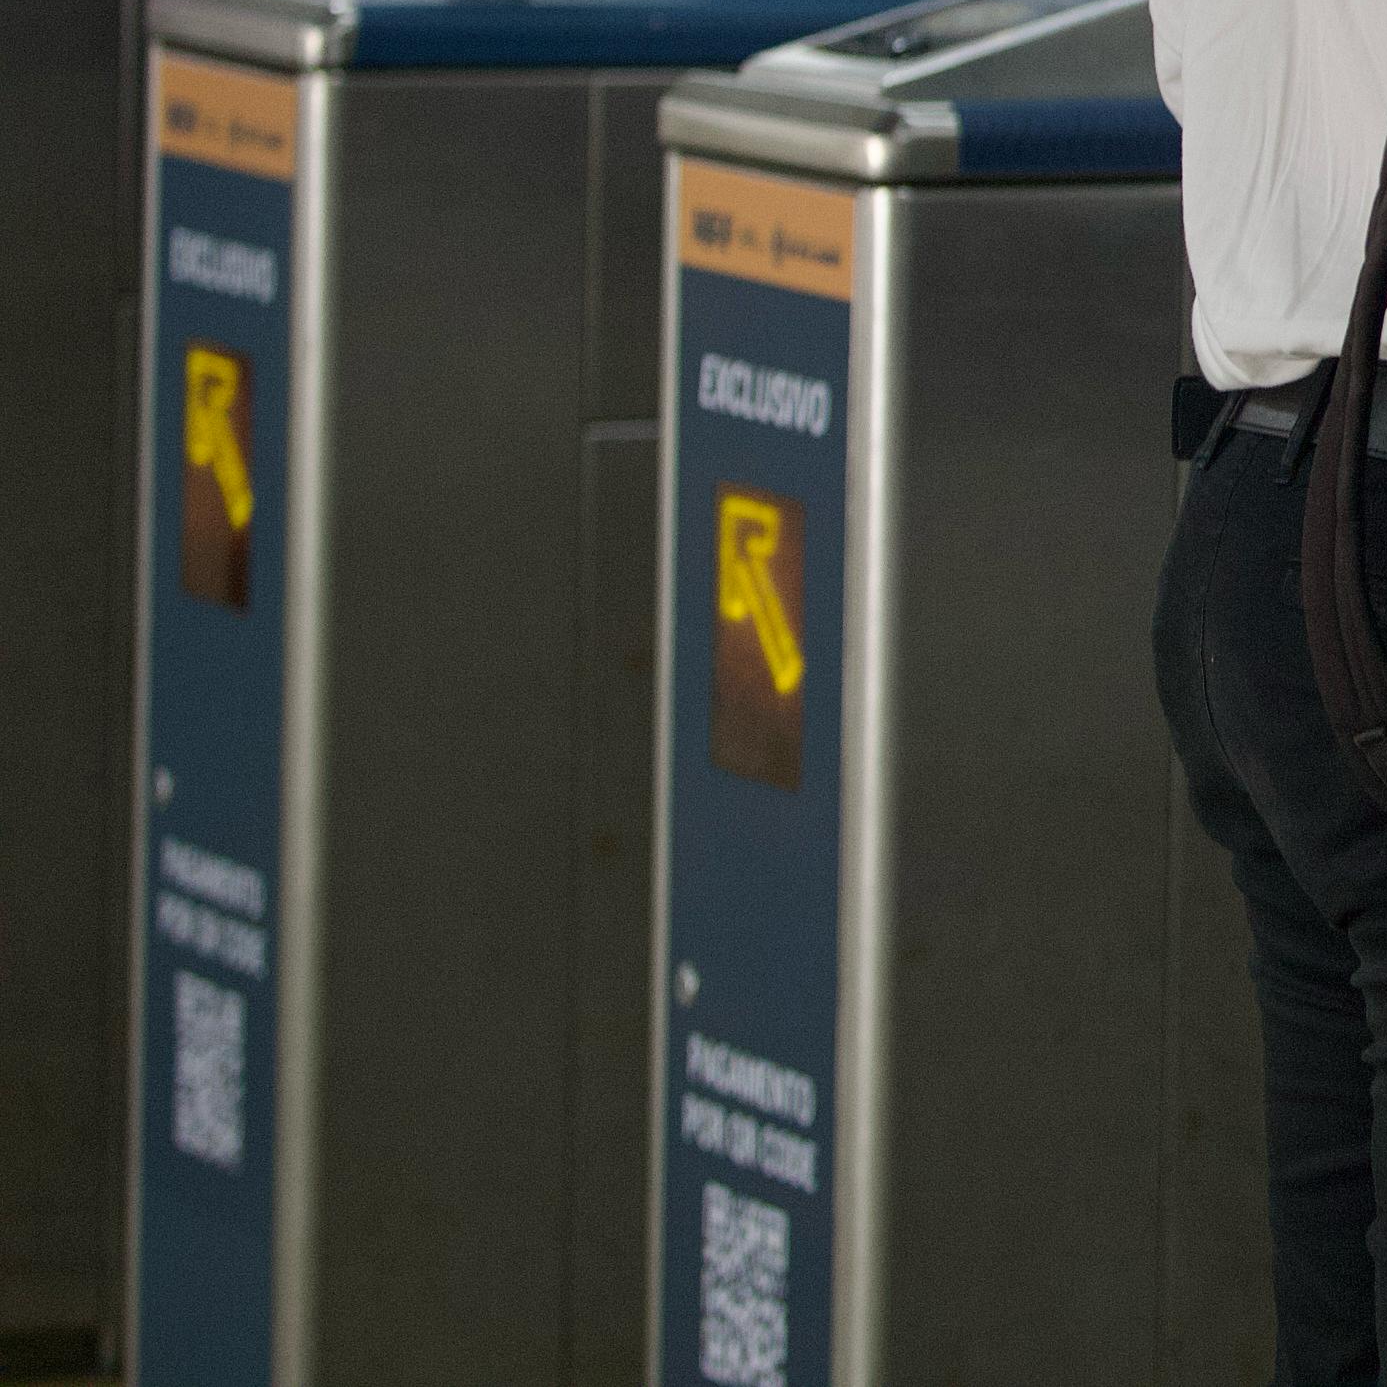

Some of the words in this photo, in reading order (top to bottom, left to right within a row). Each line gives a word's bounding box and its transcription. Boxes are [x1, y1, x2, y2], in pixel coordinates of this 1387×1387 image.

[698, 352, 832, 437] EXCLUSIVO
[686, 1032, 816, 1128] PAGAMENTO
[681, 1091, 726, 1156] POR
[759, 1123, 819, 1194] CODE
